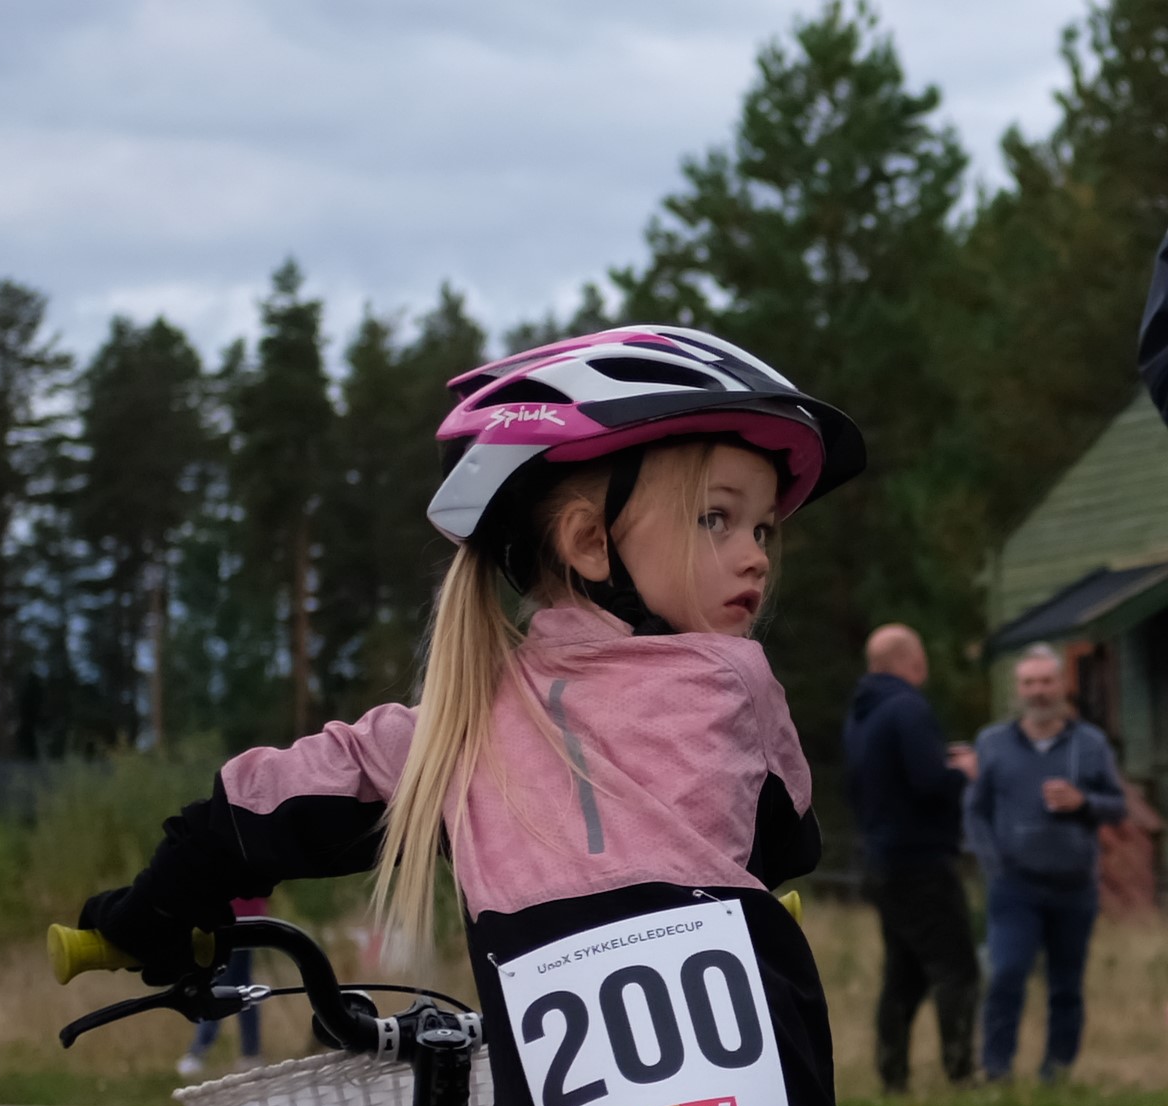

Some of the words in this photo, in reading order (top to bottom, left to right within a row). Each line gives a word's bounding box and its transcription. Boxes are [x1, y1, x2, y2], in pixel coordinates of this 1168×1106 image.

[484, 404, 566, 431] Spiuk
[537, 954, 572, 975] UnoX
[573, 919, 705, 962] SYKKELGLEDECUP
